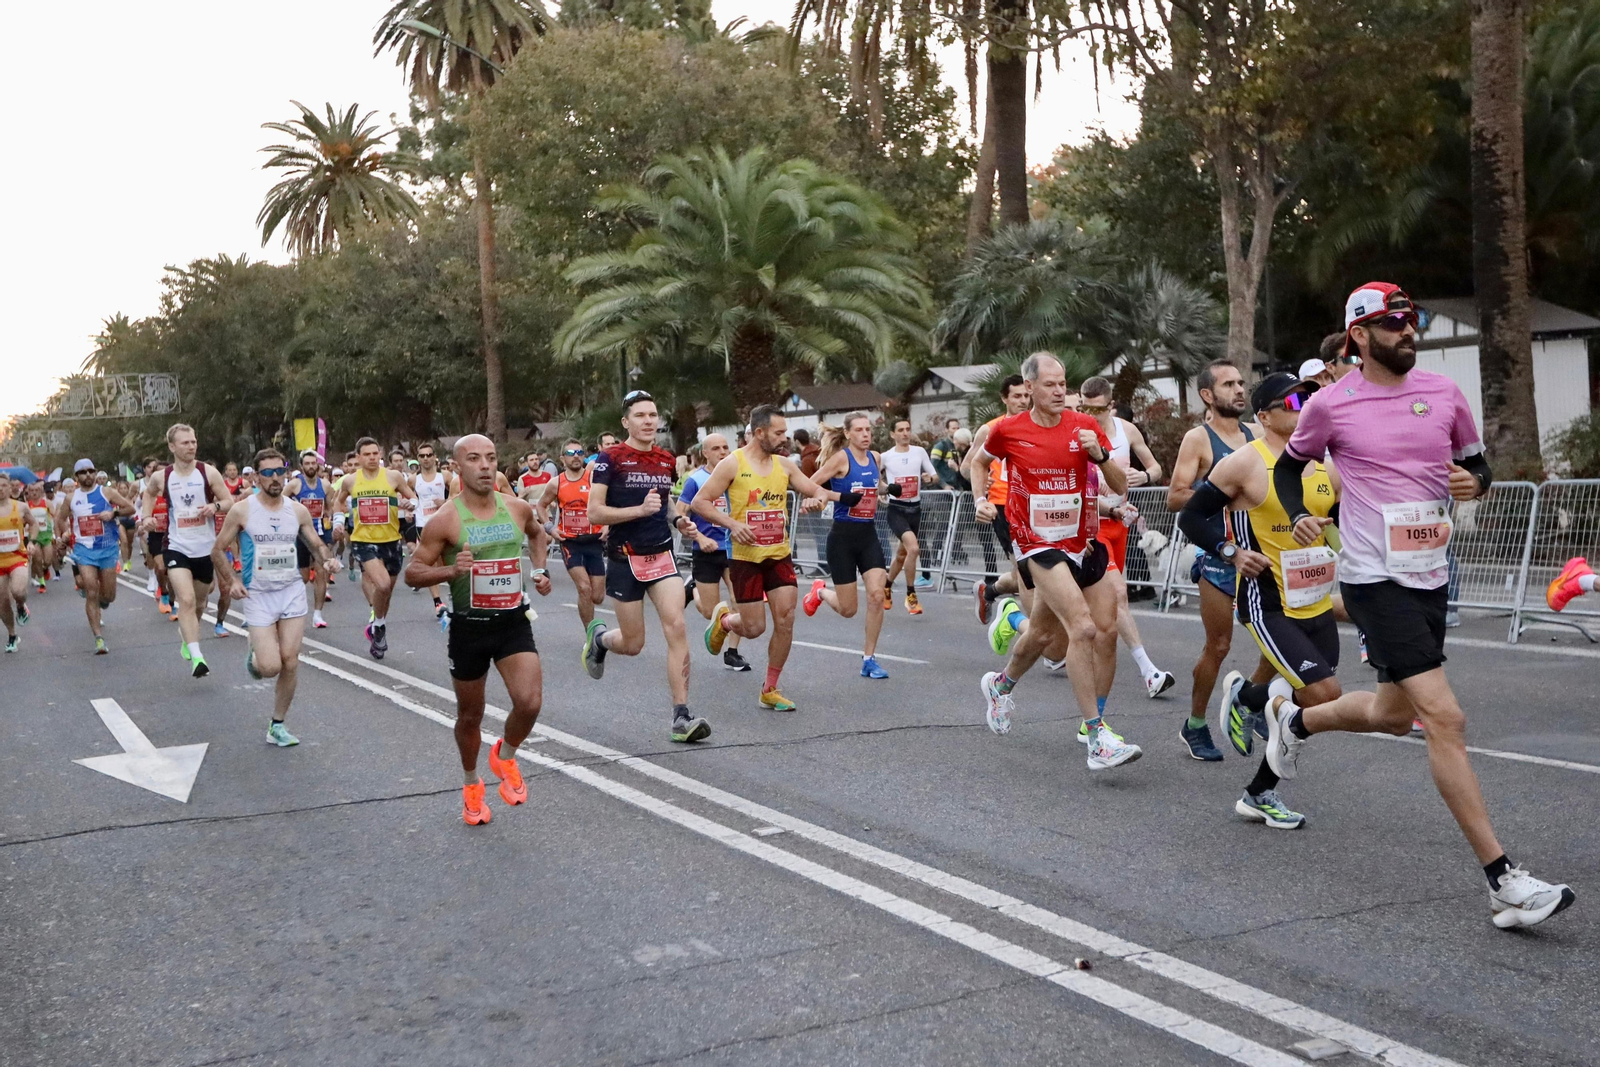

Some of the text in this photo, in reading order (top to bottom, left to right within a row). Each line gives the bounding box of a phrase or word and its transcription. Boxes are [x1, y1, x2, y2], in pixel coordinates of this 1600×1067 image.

[762, 489, 783, 500] Álora
[466, 523, 512, 537] Vicenza
[1406, 527, 1439, 539] 10516
[468, 532, 514, 545] Marathon
[1300, 567, 1326, 579] 10060
[489, 577, 511, 586] 4795
